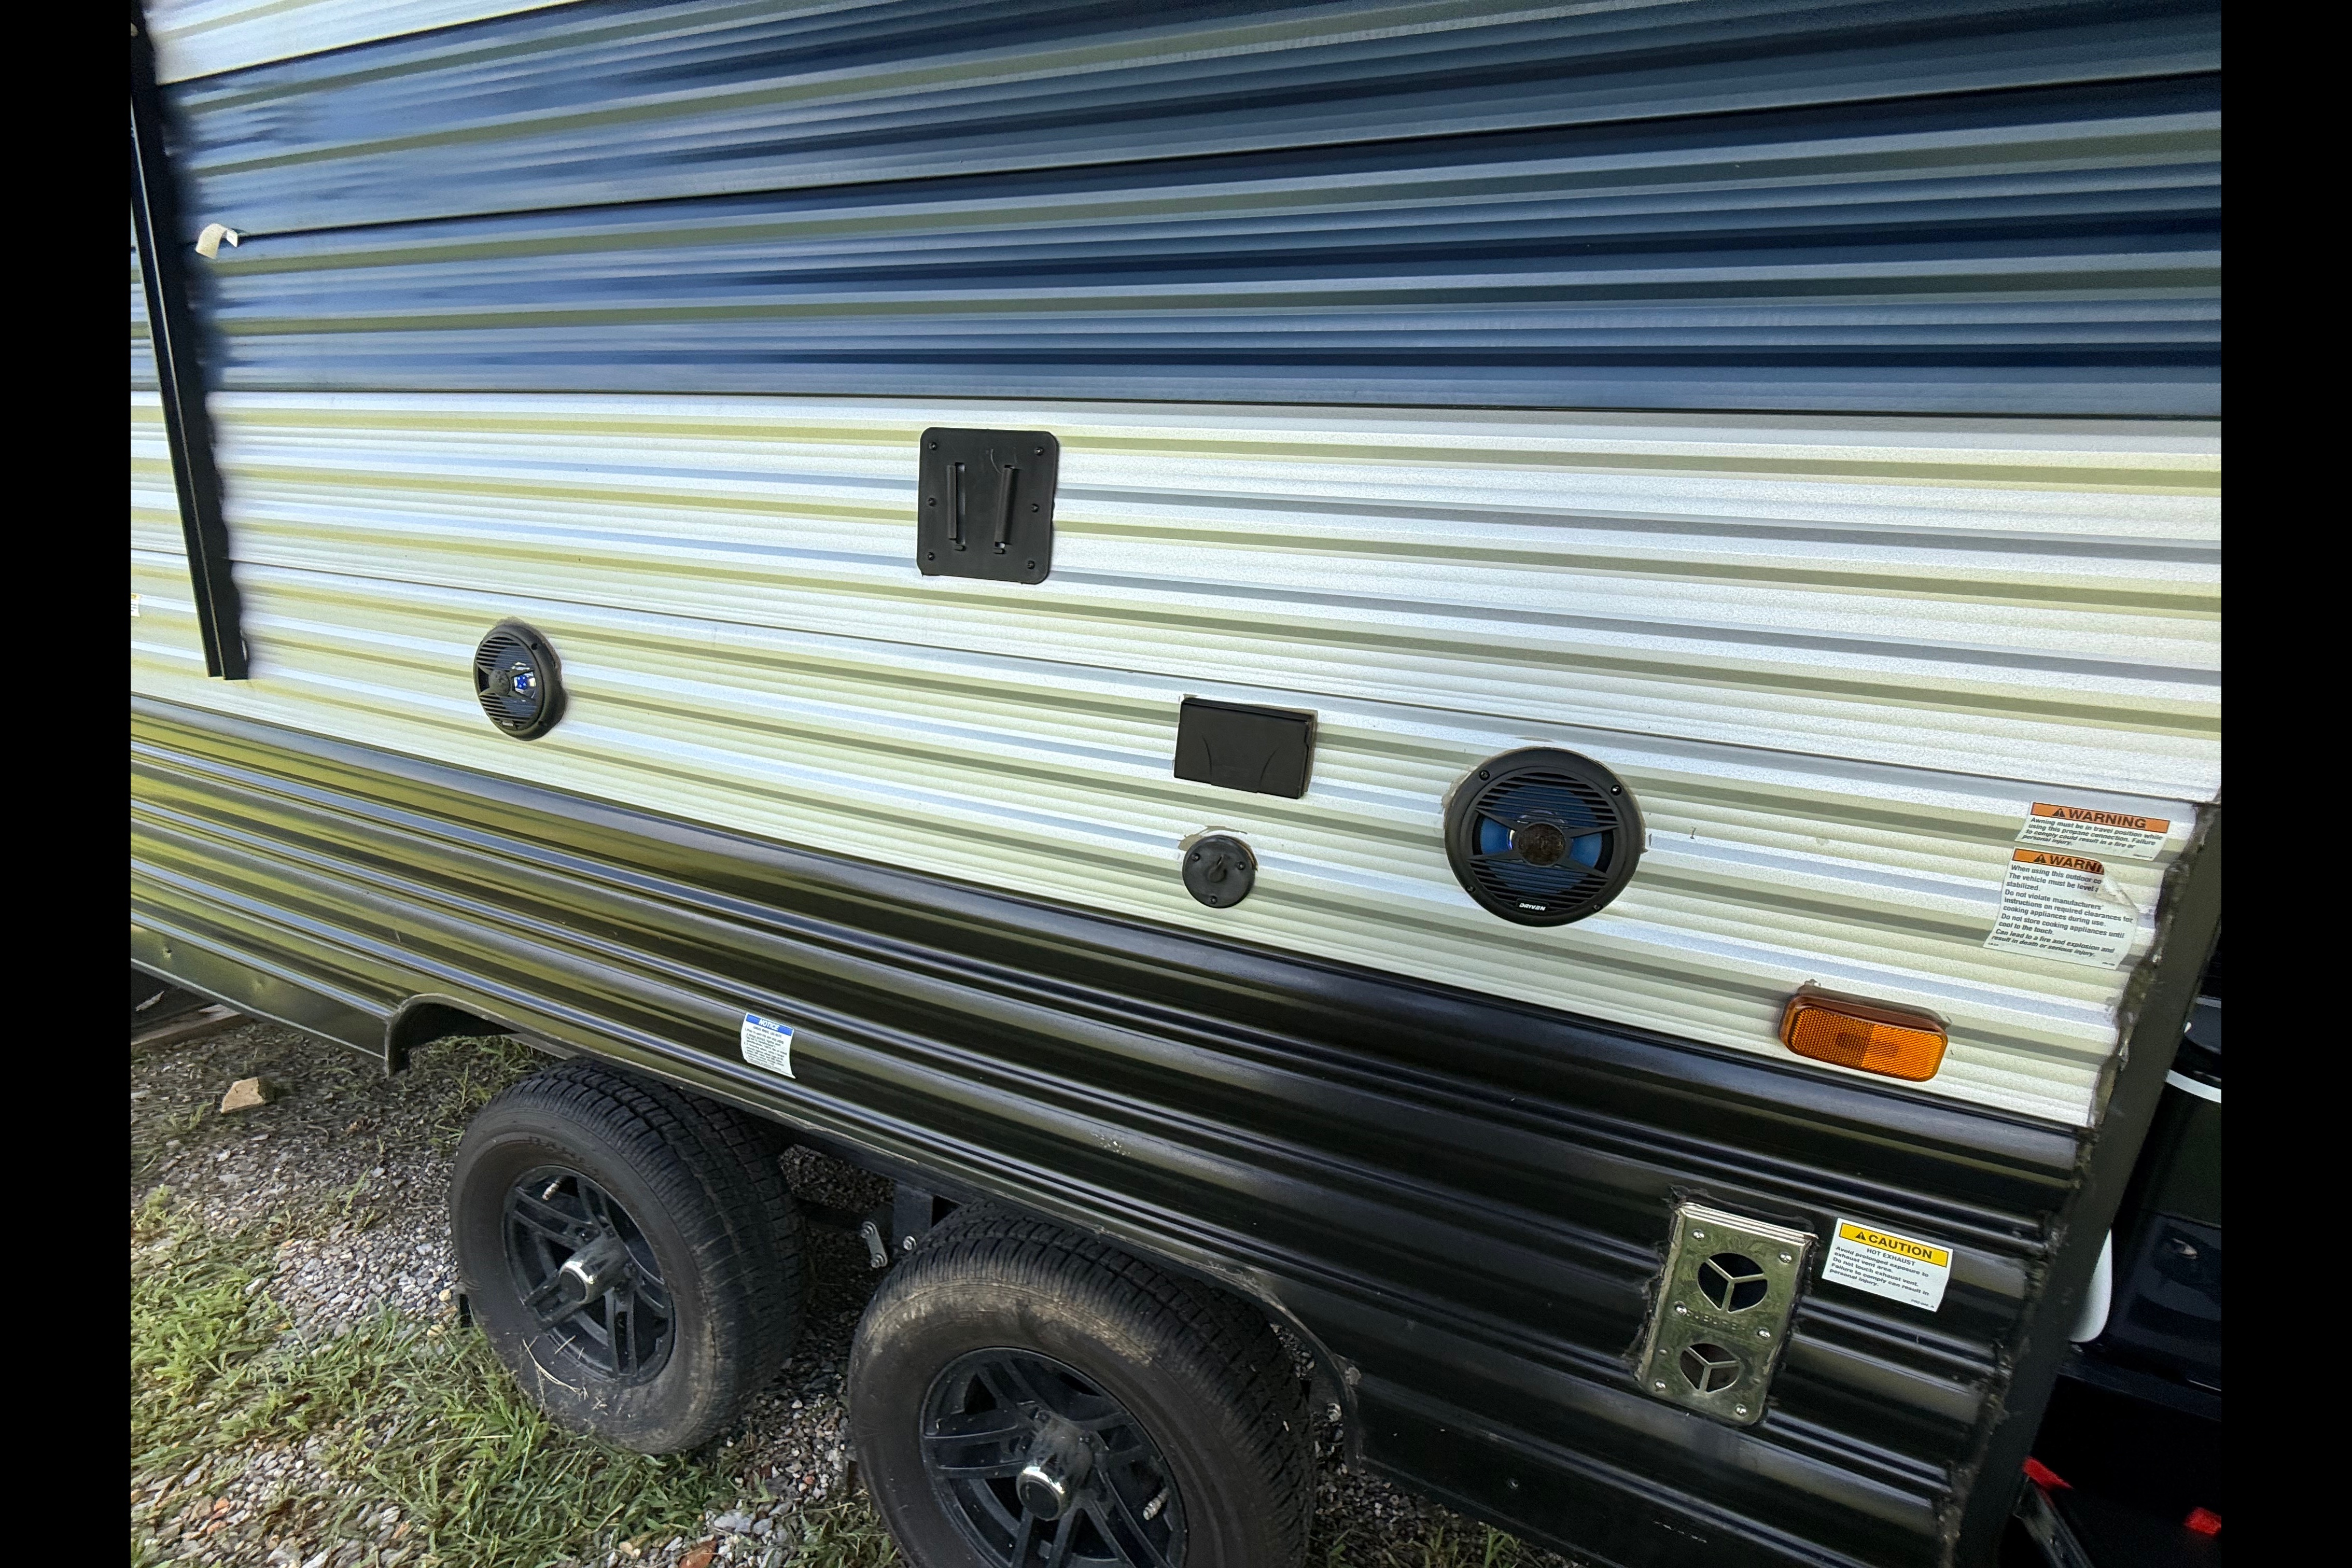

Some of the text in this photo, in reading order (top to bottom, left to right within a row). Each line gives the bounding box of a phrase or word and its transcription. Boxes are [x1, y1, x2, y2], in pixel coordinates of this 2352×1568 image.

[2031, 817, 2055, 825] Awning
[2069, 809, 2146, 828] WARNING
[2091, 832, 2130, 842] connection.
[2050, 855, 2104, 873] WARNI
[2022, 875, 2046, 884] vehicle
[2077, 883, 2094, 891] level
[2032, 867, 2050, 876] using
[2065, 874, 2092, 883] outdoor
[2006, 881, 2041, 891] stabilized.
[1519, 903, 1546, 911] DRIVEN
[2003, 905, 2028, 915] cooking
[2030, 910, 2066, 920] appliances
[2068, 915, 2090, 925] during
[2005, 897, 2042, 908] instructions
[2054, 906, 2082, 915] required
[2084, 911, 2121, 921] clearances
[2034, 927, 2054, 935] touch.
[2042, 920, 2068, 931] cooking
[2070, 925, 2108, 935] appliances
[2066, 942, 2100, 951] explosion
[759, 1019, 780, 1031] NOTICE
[1868, 1235, 1933, 1259] CAUTION
[1834, 1252, 1860, 1263] exhaust
[1836, 1247, 1854, 1255] Avoid
[1855, 1253, 1888, 1265] prolonged
[1889, 1263, 1920, 1275] exposure
[1883, 1253, 1916, 1266] EXHAUST
[1829, 1269, 1879, 1286] personal injury.
[1831, 1263, 1854, 1273] Failure
[1863, 1273, 1886, 1283] comply
[1855, 1264, 1873, 1273] touch
[1875, 1271, 1901, 1281] exhaust
